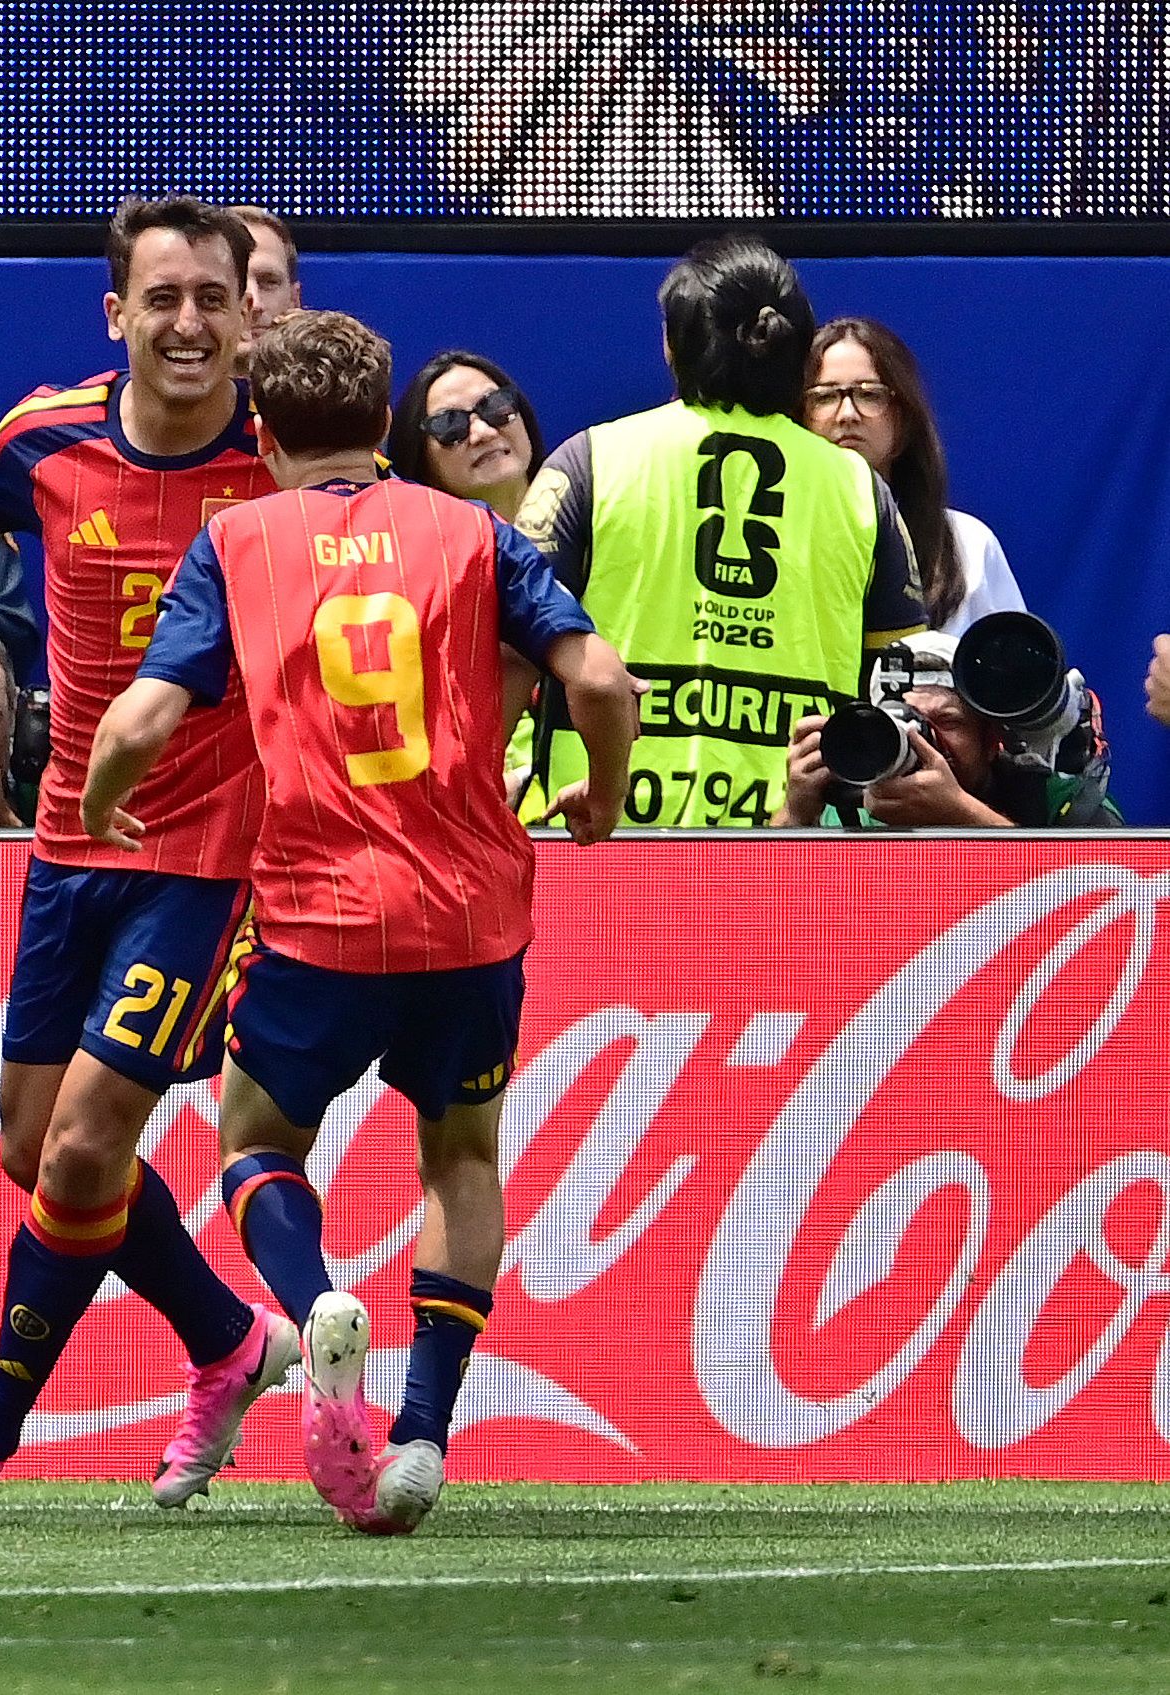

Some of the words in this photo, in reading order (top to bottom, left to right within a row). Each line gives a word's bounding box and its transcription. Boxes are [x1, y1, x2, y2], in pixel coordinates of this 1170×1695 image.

[314, 532, 393, 567] GAVI
[715, 562, 754, 585] FIFA
[120, 572, 164, 648] 2
[693, 619, 774, 649] 2026
[743, 608, 775, 622] CUP
[313, 591, 431, 787] 9
[639, 679, 835, 738] ECURIT
[624, 768, 786, 827] 0794
[103, 963, 192, 1057] 21
